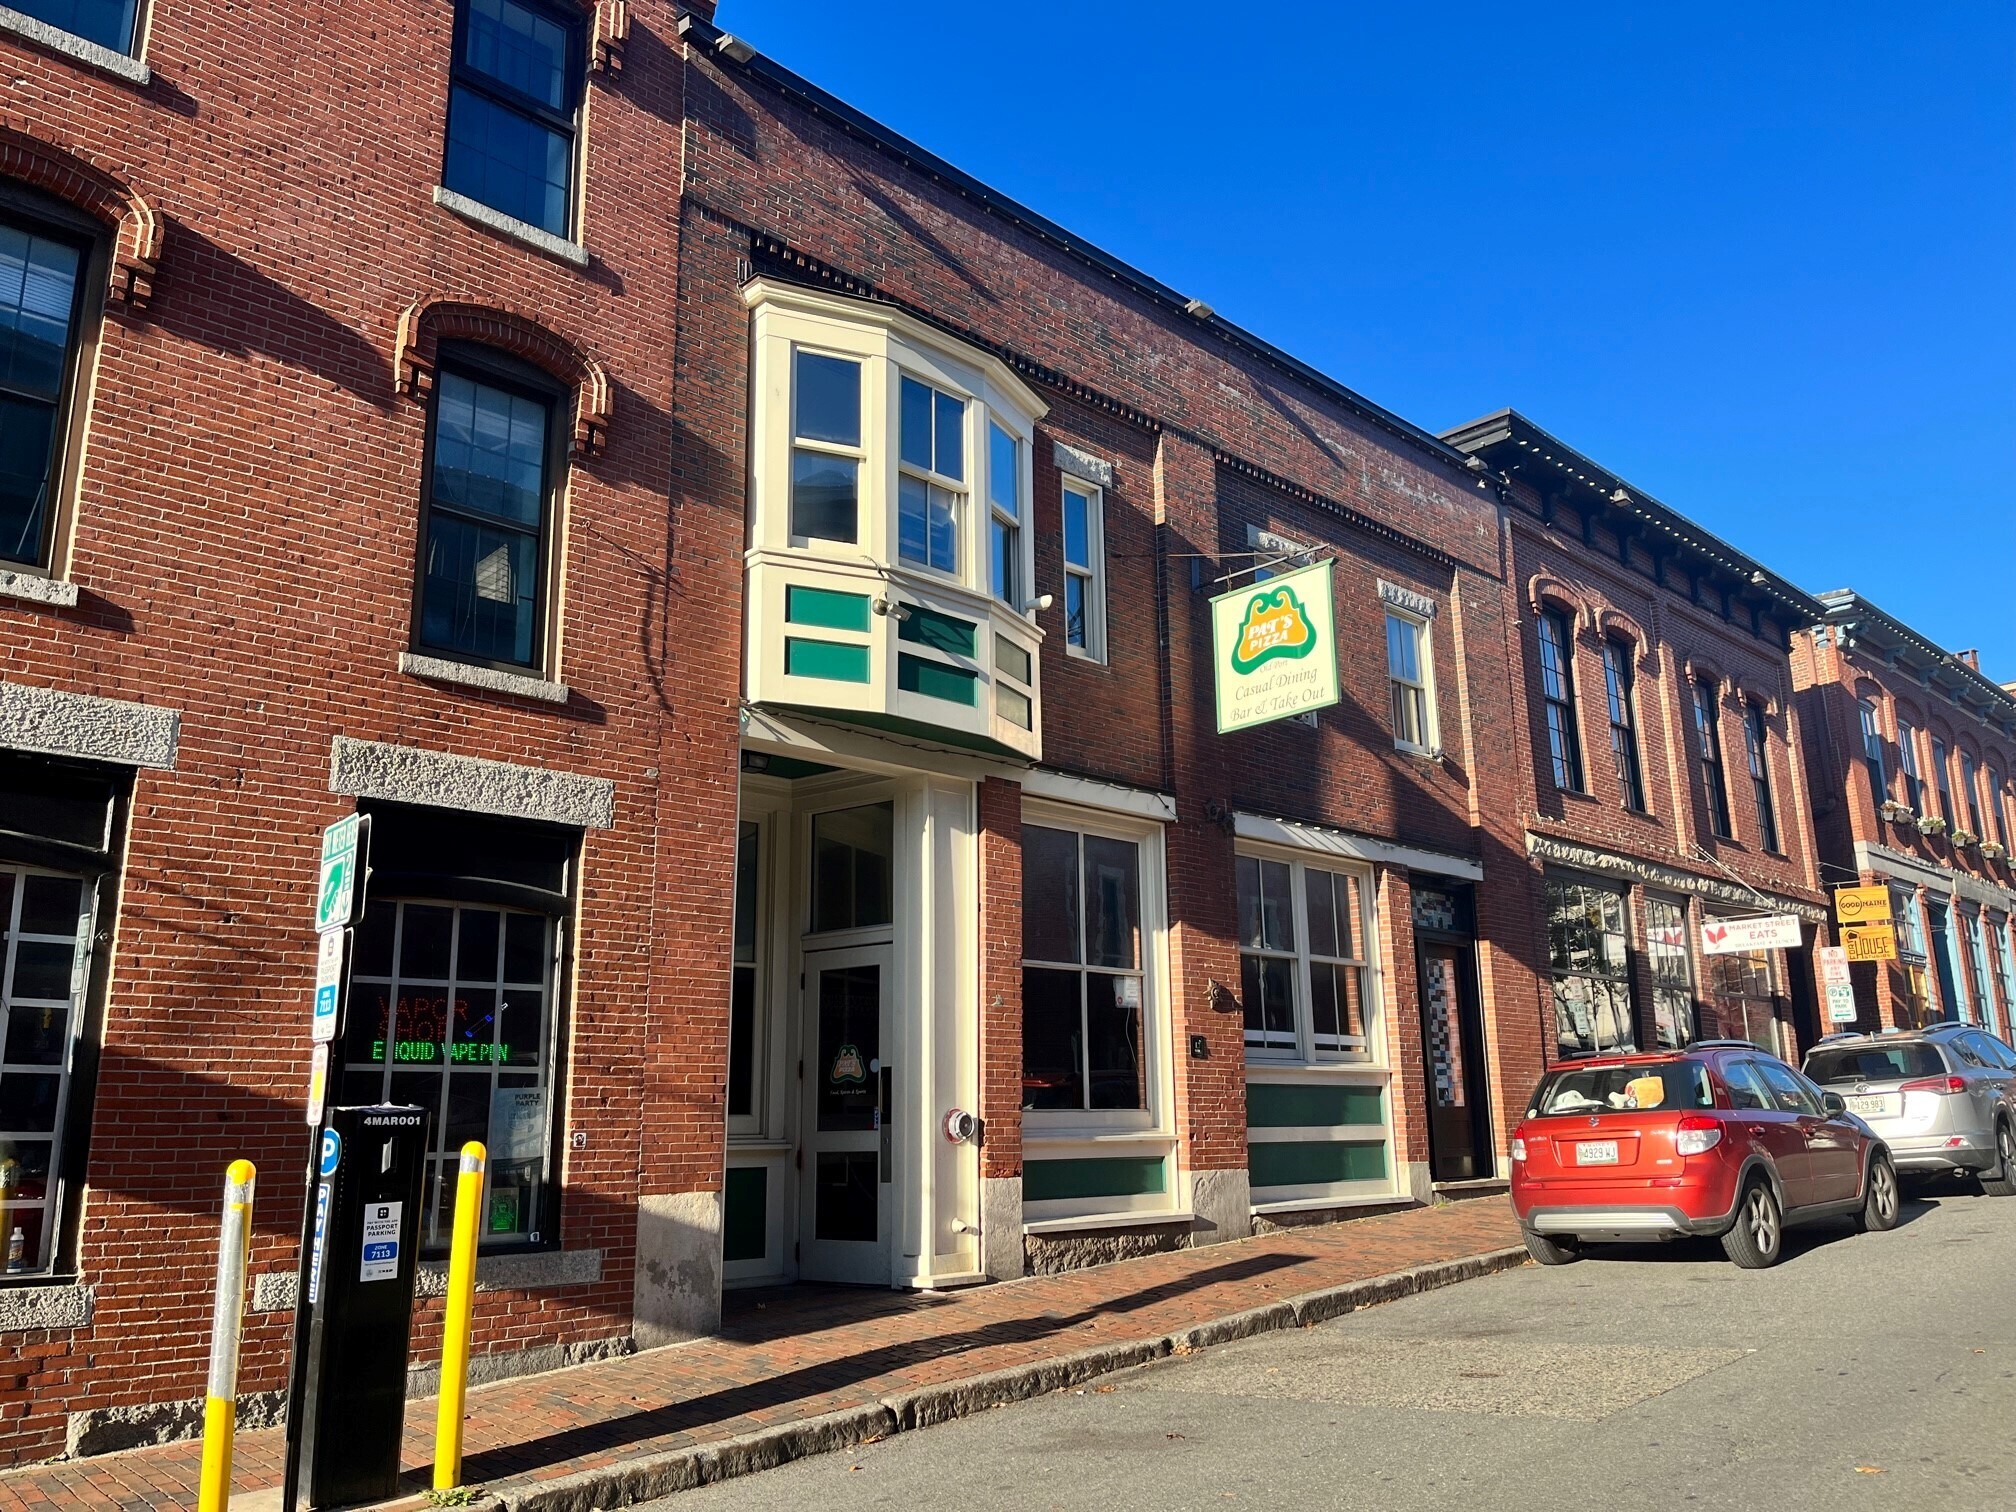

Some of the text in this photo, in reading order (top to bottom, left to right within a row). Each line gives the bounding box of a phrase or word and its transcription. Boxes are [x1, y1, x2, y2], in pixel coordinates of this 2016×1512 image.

[1248, 614, 1294, 640] PAT'S
[1250, 632, 1289, 651] PIZZA
[1260, 660, 1288, 673] Old Port
[1236, 668, 1318, 700] Casual Dining
[1230, 686, 1326, 722] Bar & Take Out
[346, 852, 352, 876] 2
[1728, 918, 1796, 931] MARKET STREET
[1750, 930, 1778, 940] EATS
[1854, 936, 1889, 959] HOUSE
[1870, 1100, 1883, 1108] 983
[322, 1138, 336, 1166] P
[1584, 1147, 1616, 1158] 4929 WJ
[372, 1250, 390, 1259] 7113
